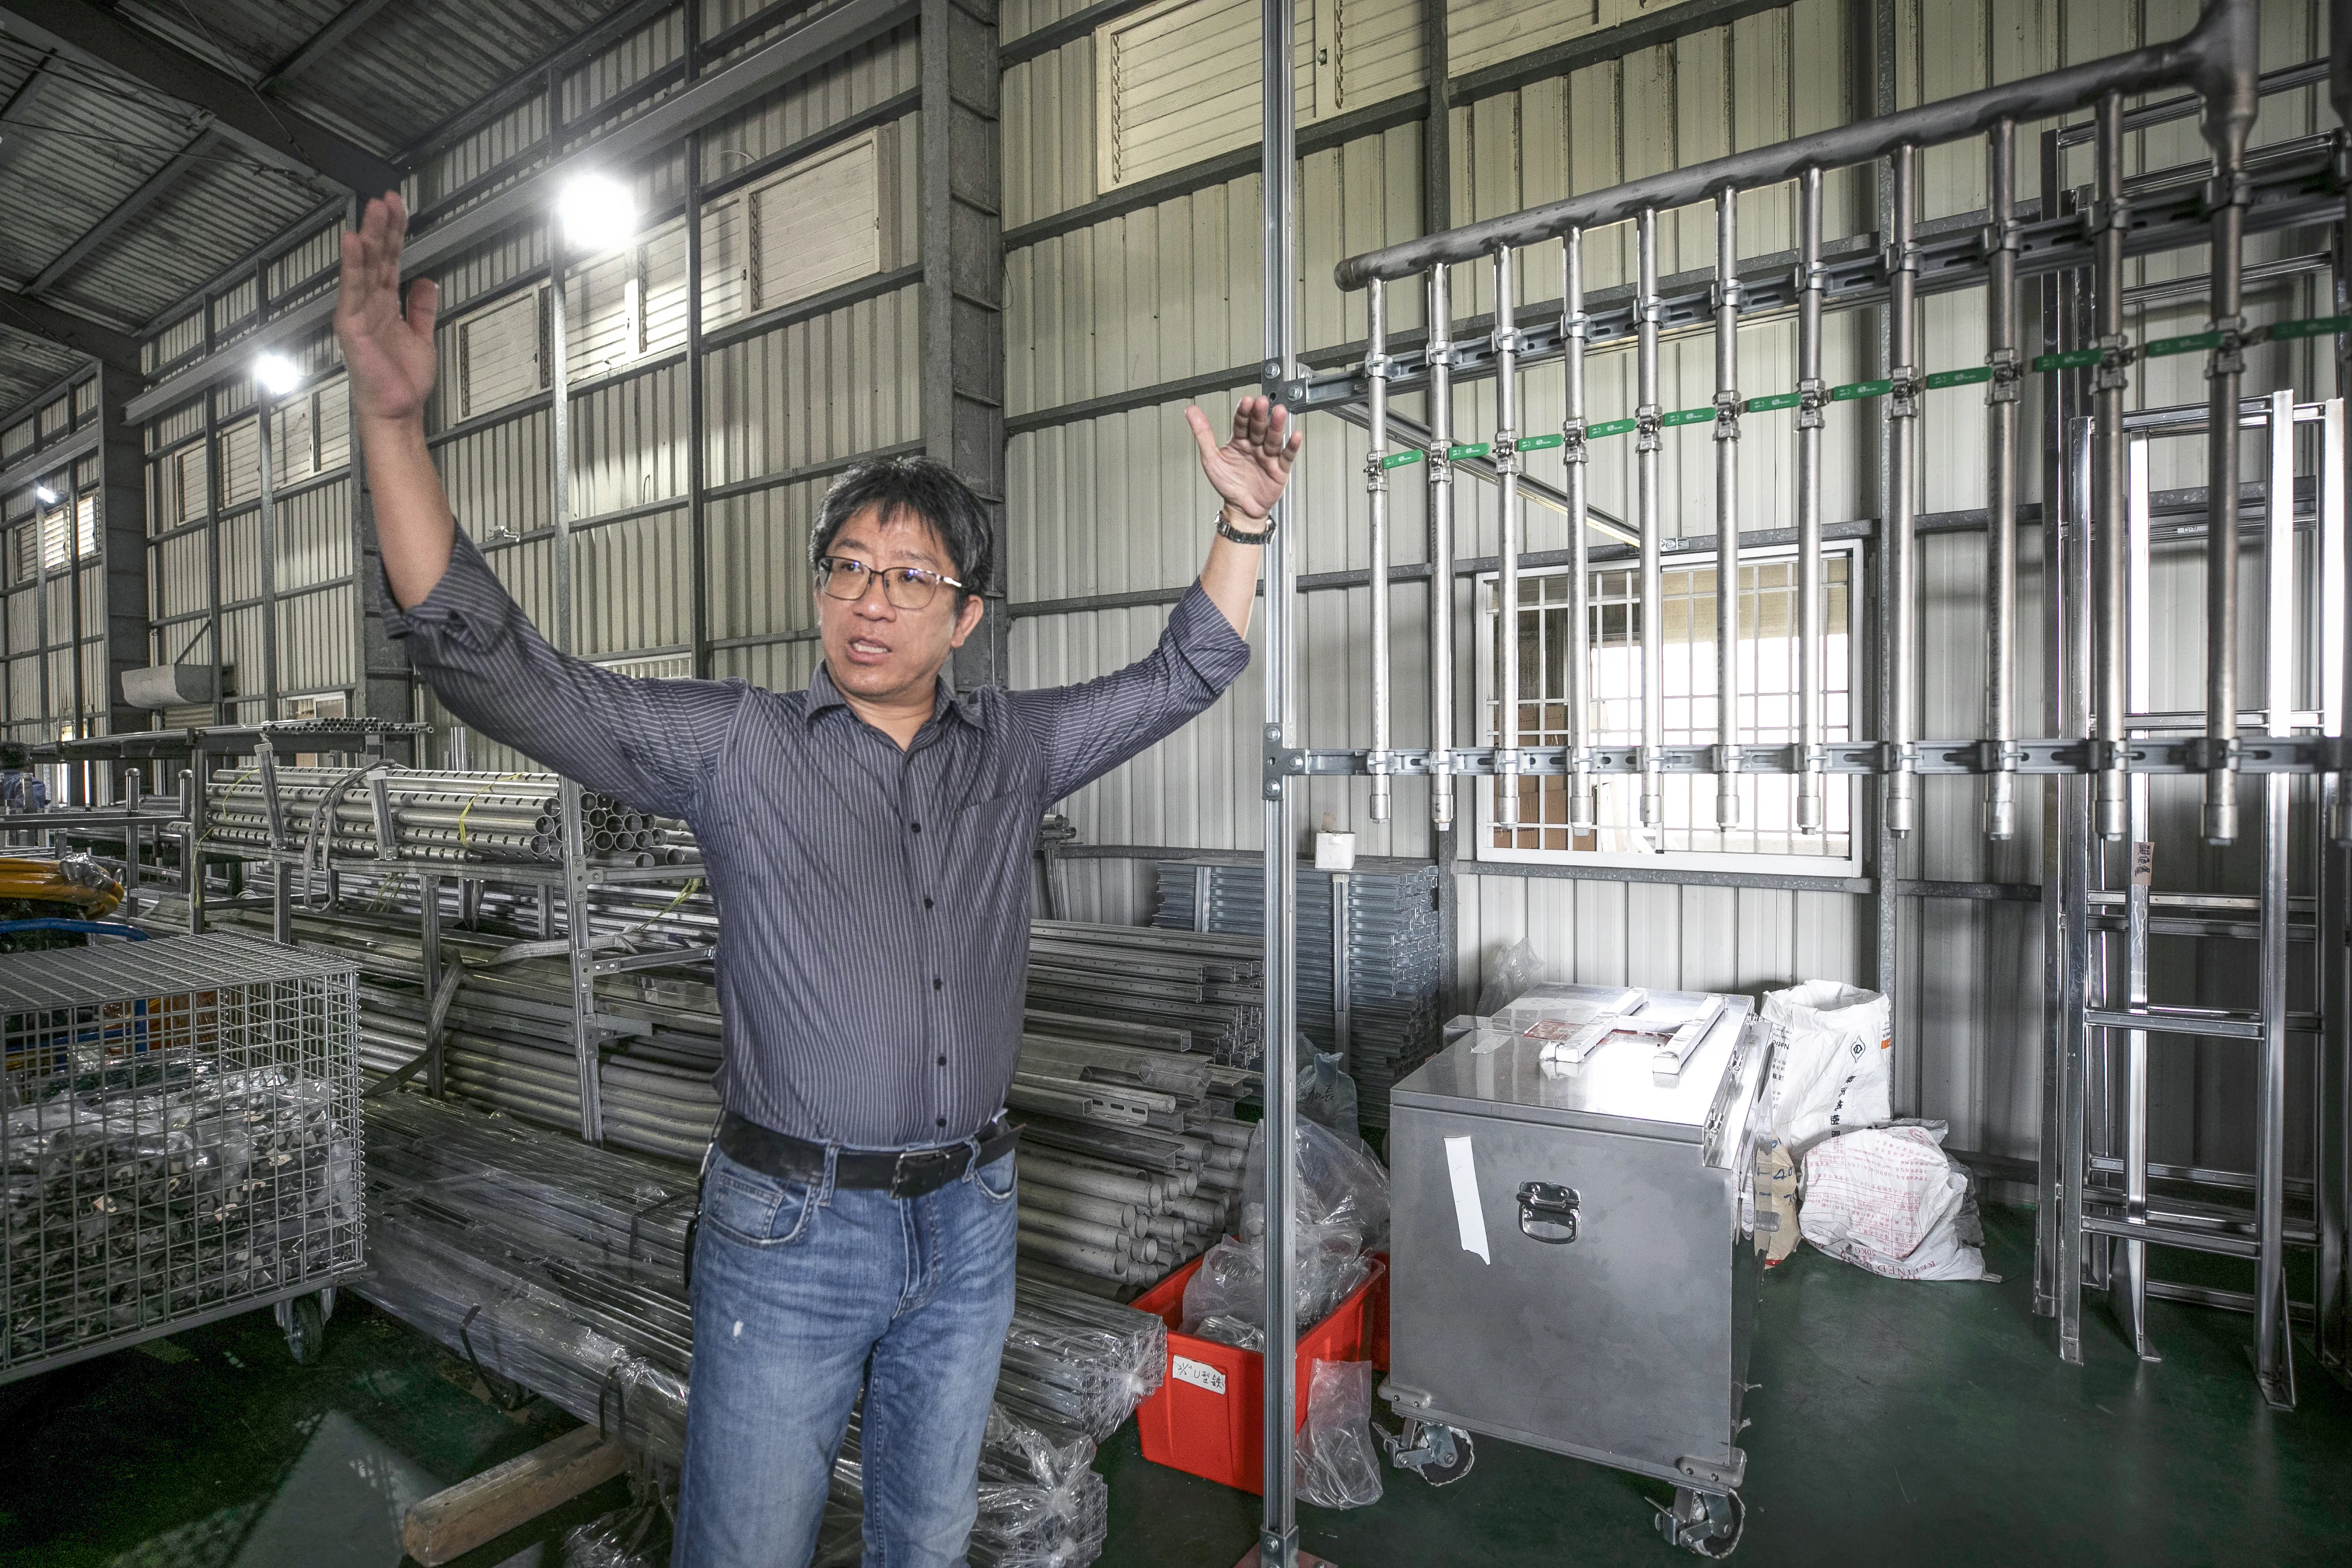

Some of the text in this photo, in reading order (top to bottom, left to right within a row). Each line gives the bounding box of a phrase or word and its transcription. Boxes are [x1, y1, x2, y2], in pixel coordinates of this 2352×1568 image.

[1772, 1040, 1790, 1050] Notic
[1855, 1247, 1876, 1257] 50KG
[1877, 1260, 1936, 1276] REFINED
